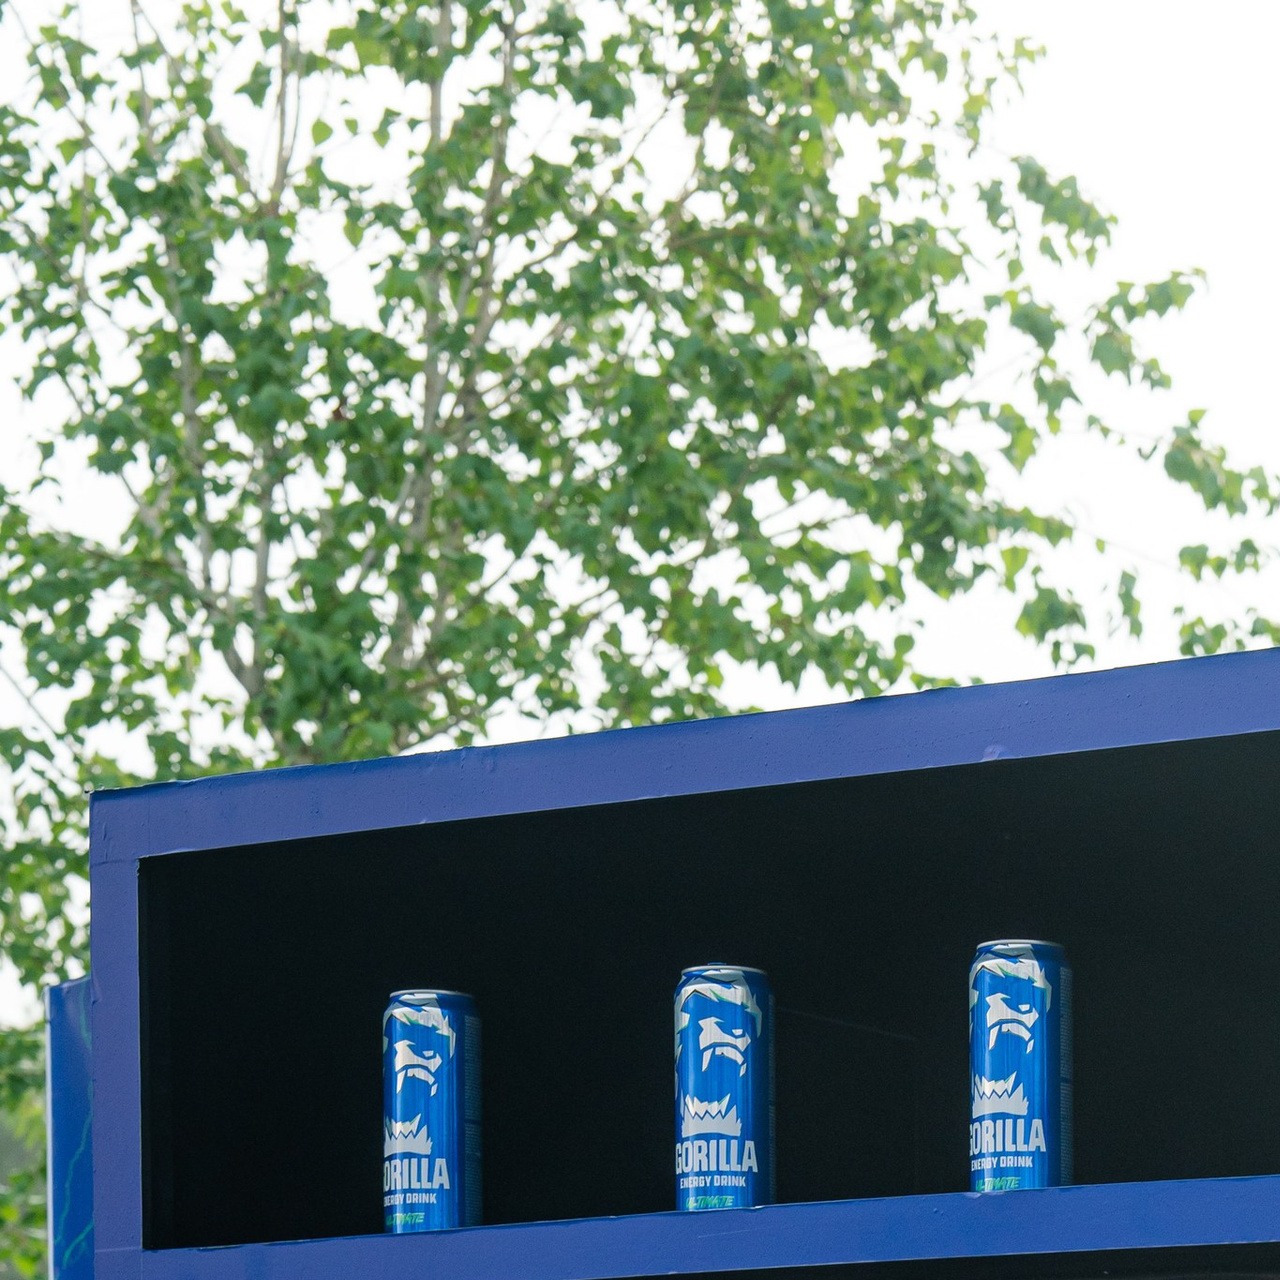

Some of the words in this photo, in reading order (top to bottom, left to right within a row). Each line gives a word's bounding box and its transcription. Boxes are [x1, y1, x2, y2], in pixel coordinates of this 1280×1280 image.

[676, 1139, 758, 1174] GORILLA
[1000, 1156, 1033, 1168] DRINK
[383, 1158, 450, 1191] ORILLA
[680, 1176, 711, 1189] ENERGY
[714, 1175, 746, 1187] DRINK
[406, 1193, 437, 1204] DRINK
